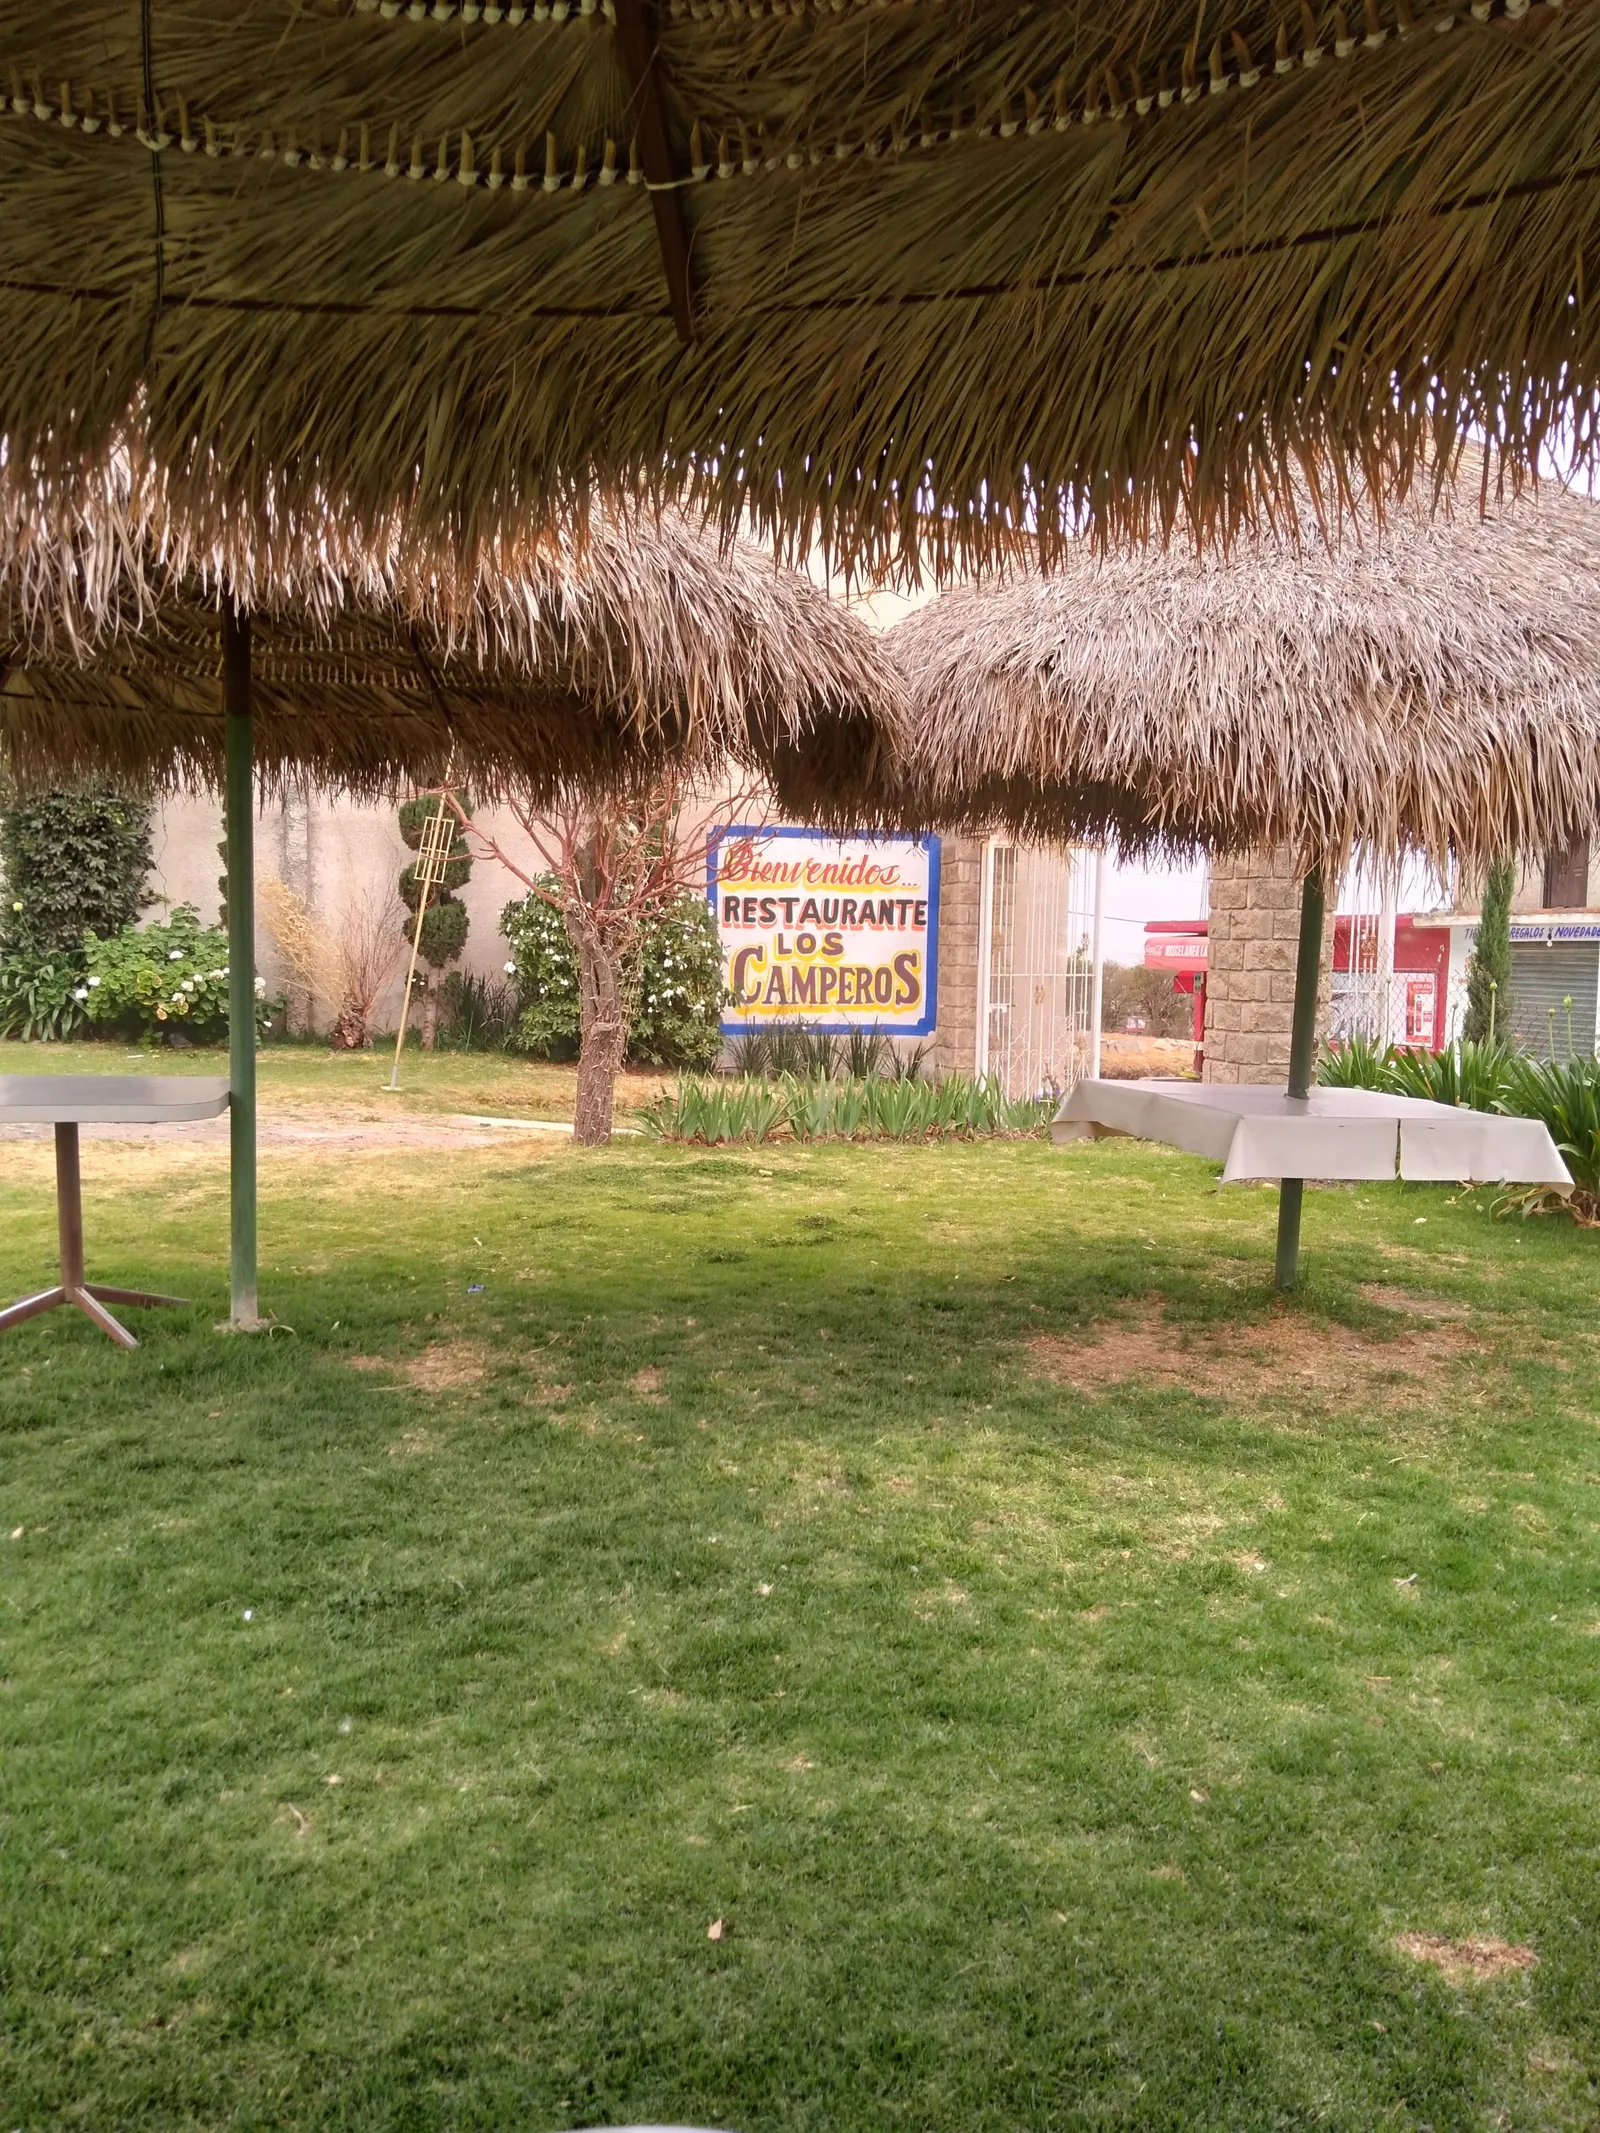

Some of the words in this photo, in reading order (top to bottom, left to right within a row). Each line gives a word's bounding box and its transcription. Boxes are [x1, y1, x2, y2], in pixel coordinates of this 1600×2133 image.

[723, 895, 928, 928] RESTAURANTE
[776, 932, 845, 957] LOS
[1510, 926, 1545, 939] REGALOS
[732, 944, 921, 1007] CAMPEROS
